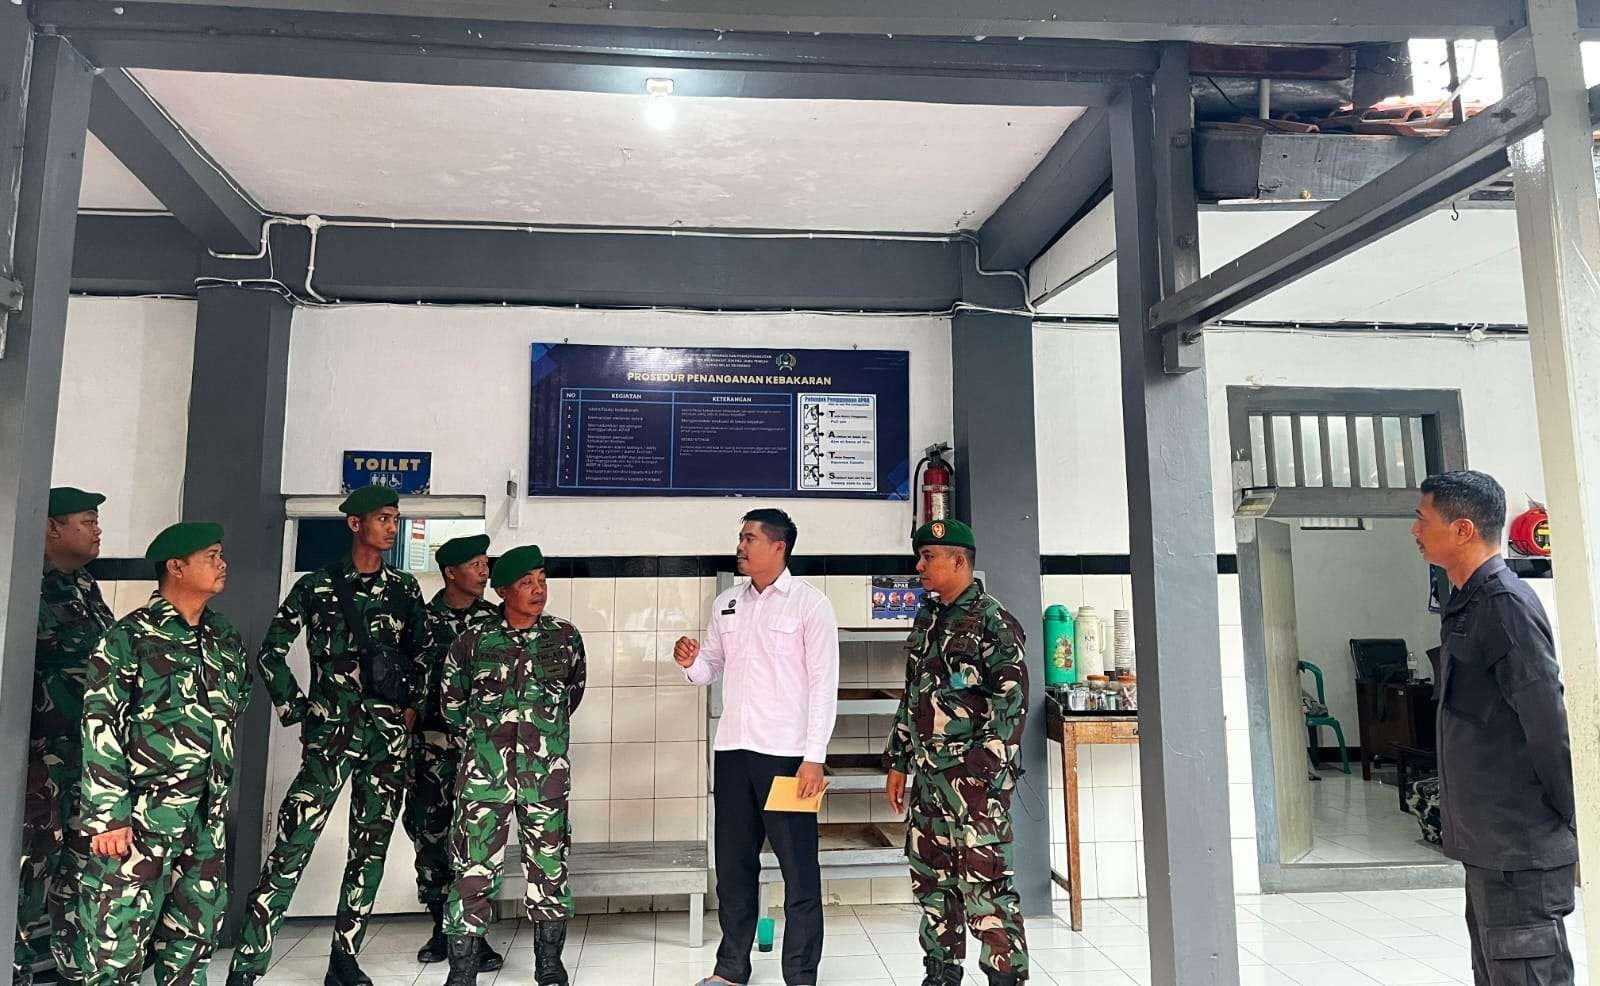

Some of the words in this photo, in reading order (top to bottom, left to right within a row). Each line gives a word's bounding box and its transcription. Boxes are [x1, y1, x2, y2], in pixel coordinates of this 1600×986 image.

[627, 372, 685, 383] PROSEDUR
[687, 374, 764, 385] PENANGANAN
[766, 375, 832, 386] KEBAKARAN
[353, 457, 421, 472] TOILET
